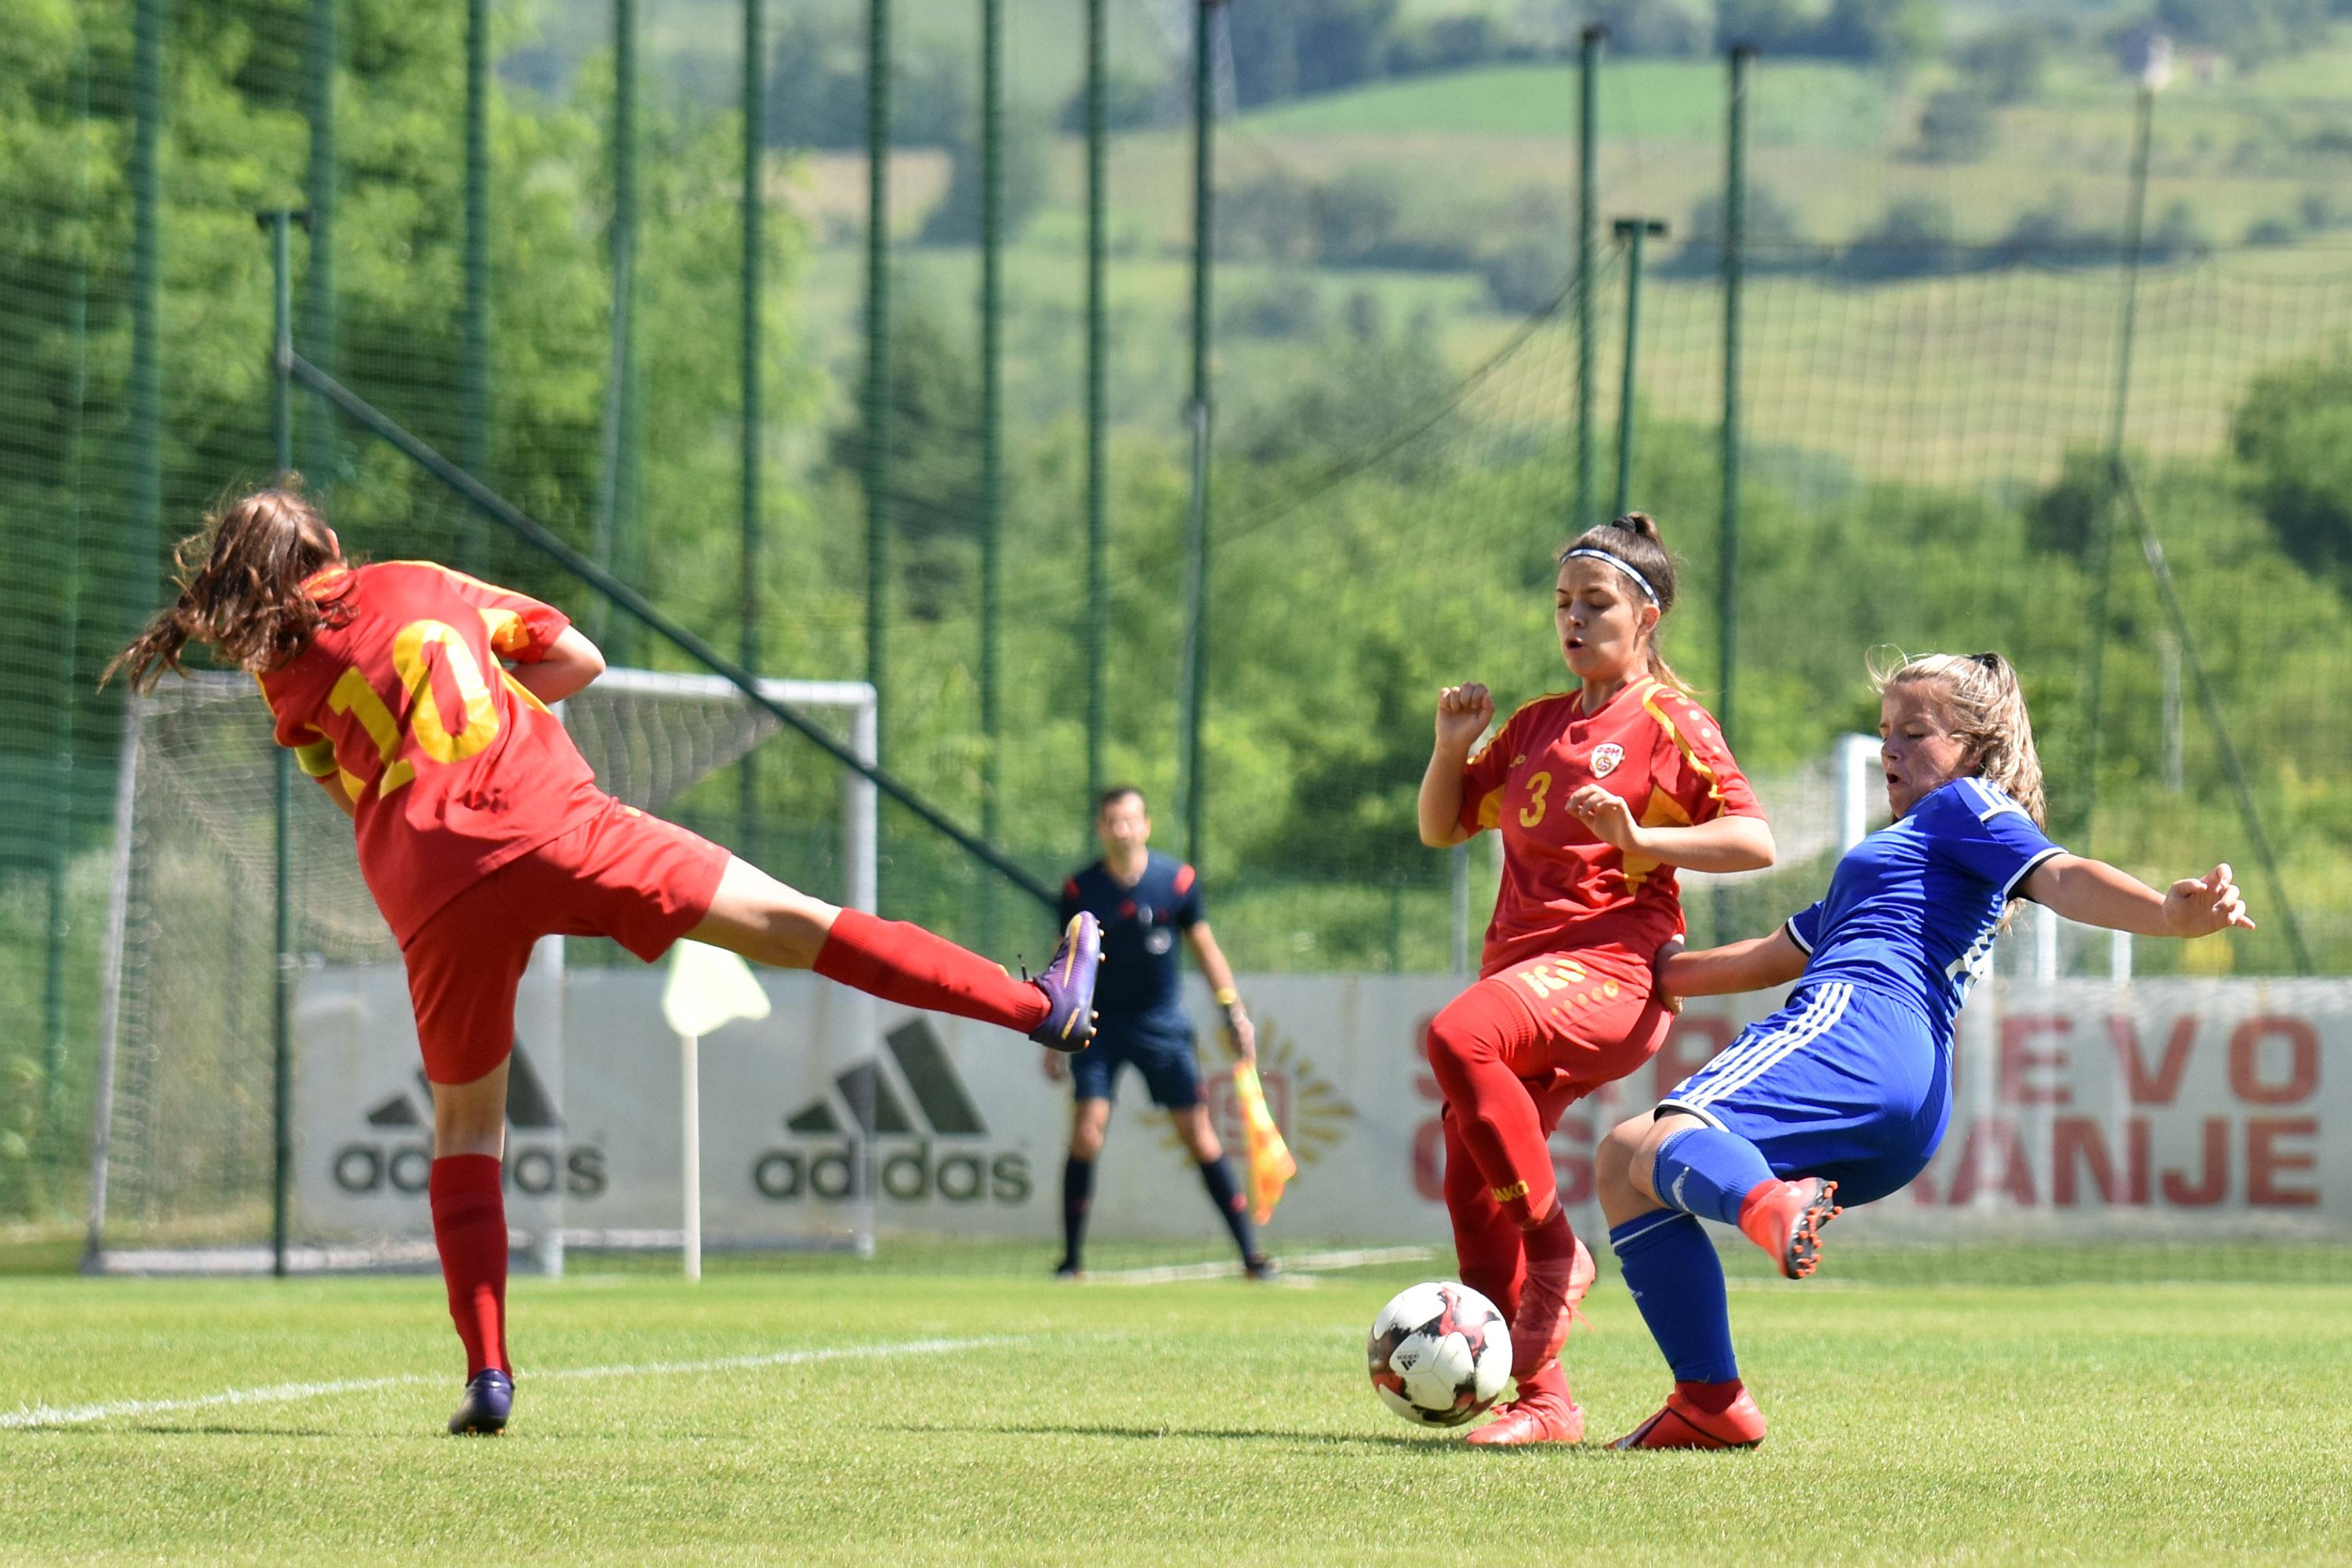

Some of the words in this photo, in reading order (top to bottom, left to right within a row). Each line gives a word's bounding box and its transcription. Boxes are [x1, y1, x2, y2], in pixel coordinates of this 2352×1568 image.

[328, 619, 499, 800] 10
[1519, 771, 1552, 828] 3
[333, 1131, 607, 1200] adas
